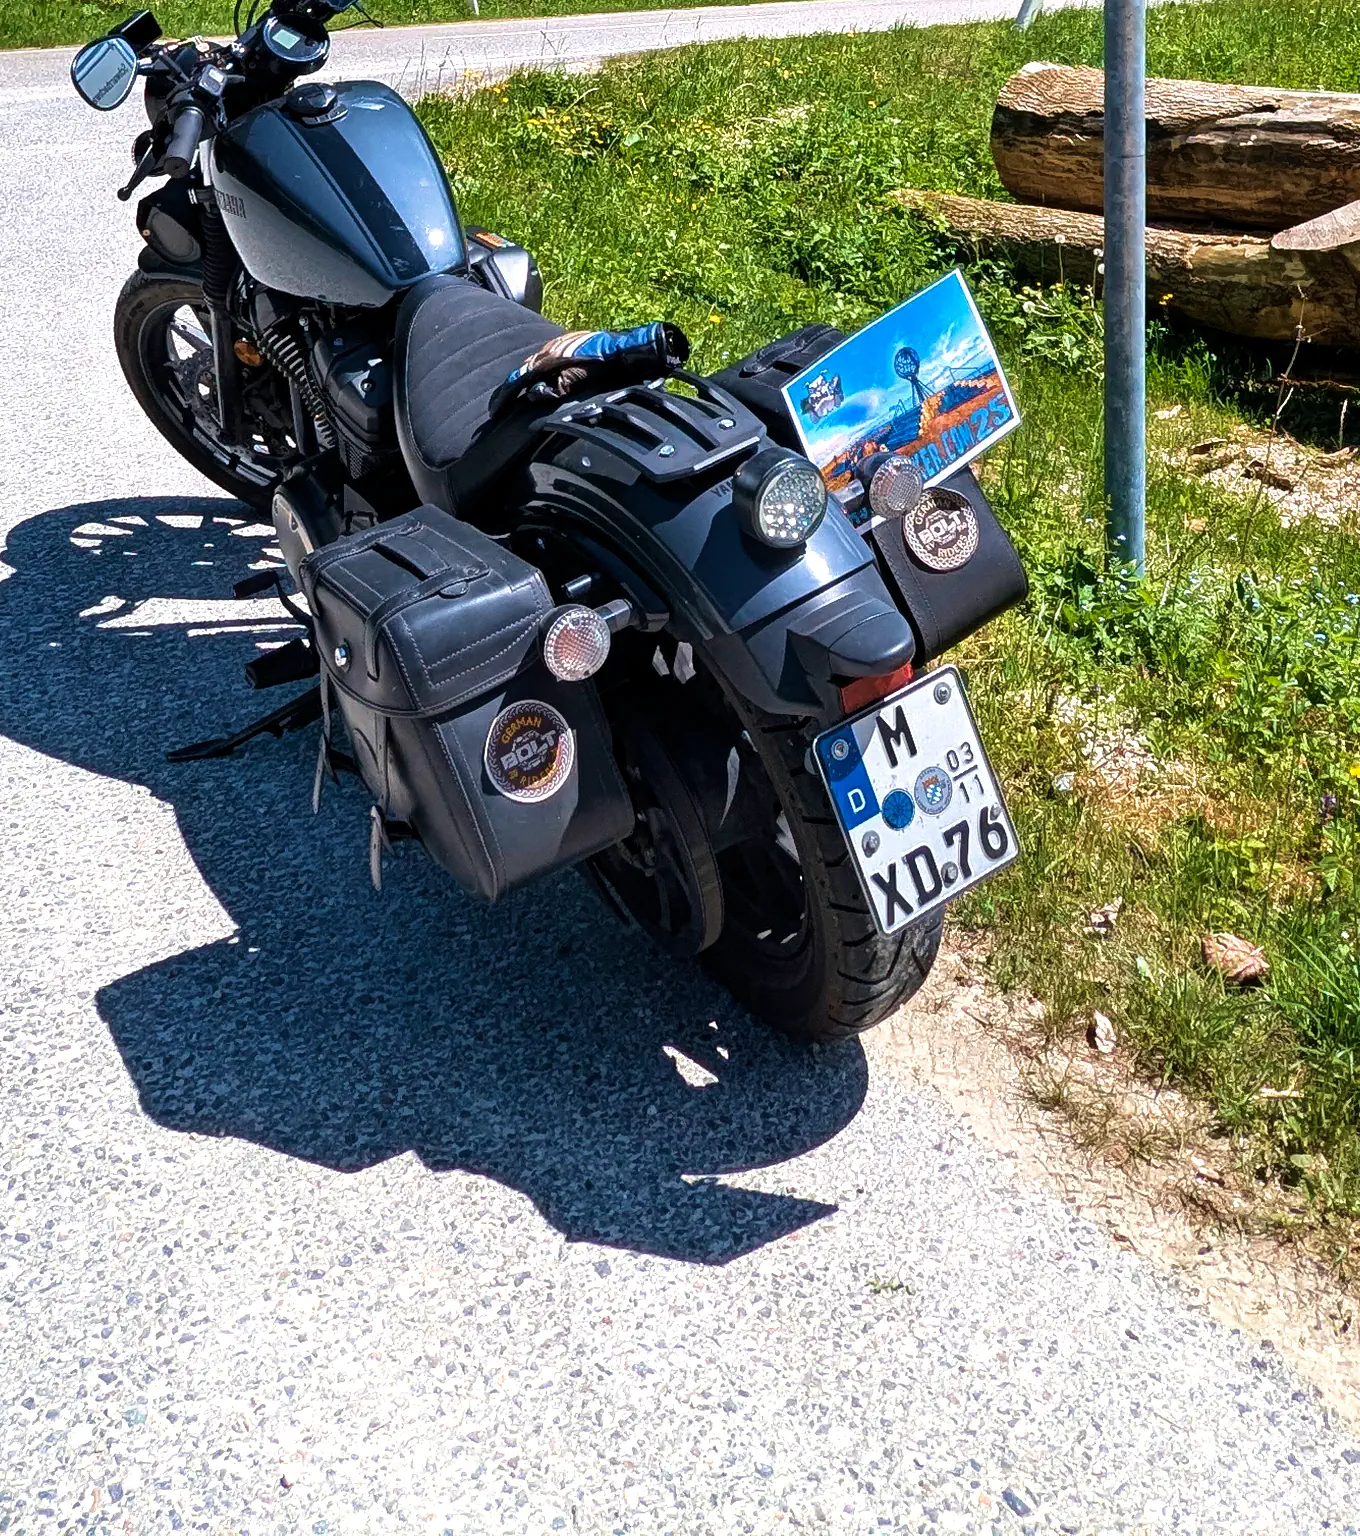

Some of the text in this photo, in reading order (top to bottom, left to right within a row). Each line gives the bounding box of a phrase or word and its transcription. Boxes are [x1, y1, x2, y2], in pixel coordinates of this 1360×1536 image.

[918, 510, 960, 545] BOLT
[938, 534, 968, 558] RIDERS
[501, 716, 542, 744] GERMAN
[876, 705, 917, 768] M
[500, 729, 556, 770] BOLT
[946, 741, 974, 771] 03
[847, 788, 866, 814] D
[959, 774, 984, 804] 11
